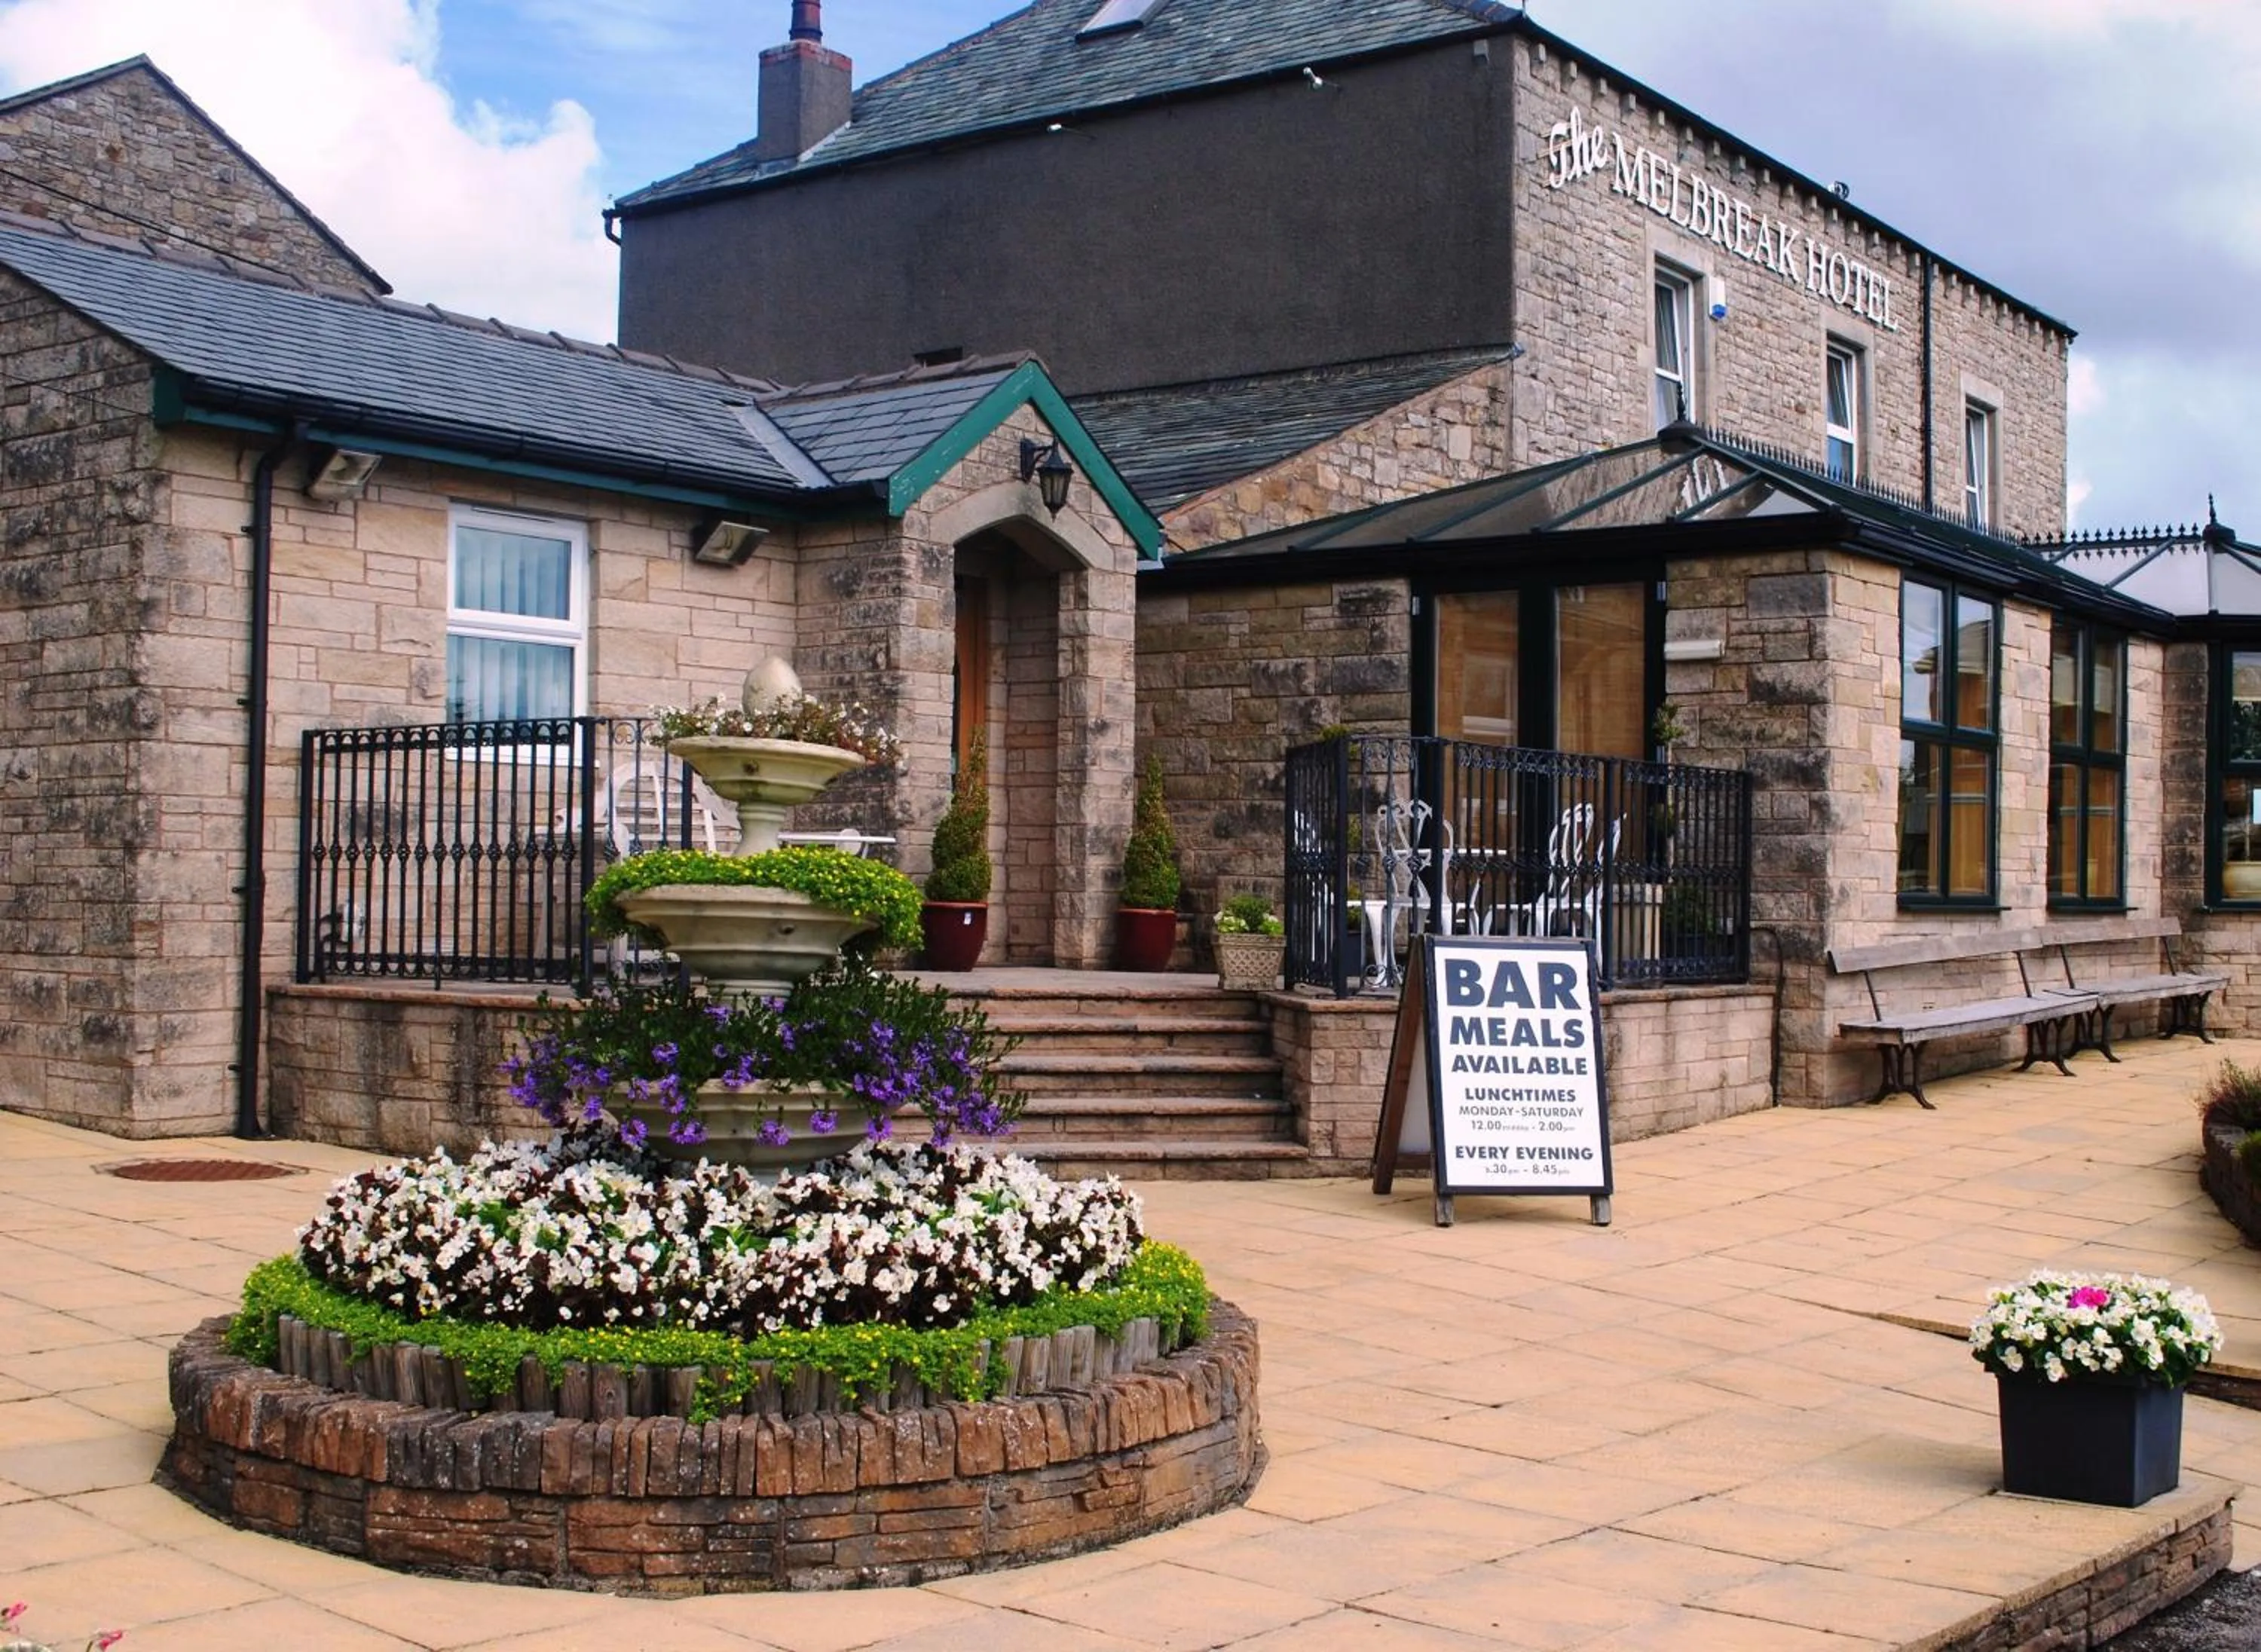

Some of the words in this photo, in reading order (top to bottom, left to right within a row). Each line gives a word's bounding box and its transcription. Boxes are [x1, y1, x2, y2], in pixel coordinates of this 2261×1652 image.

[1548, 106, 1608, 190] The
[1611, 131, 1801, 283] MELBREAK
[1806, 237, 1898, 332] HOTEL
[1445, 958, 1581, 1010] BAR
[1449, 1016, 1585, 1048] MEALS
[1452, 1054, 1587, 1075] AVAILABLE
[1464, 1088, 1577, 1103] LUNCHTIMES
[1455, 1146, 1510, 1159] EVERY
[1516, 1147, 1594, 1161] EVENING
